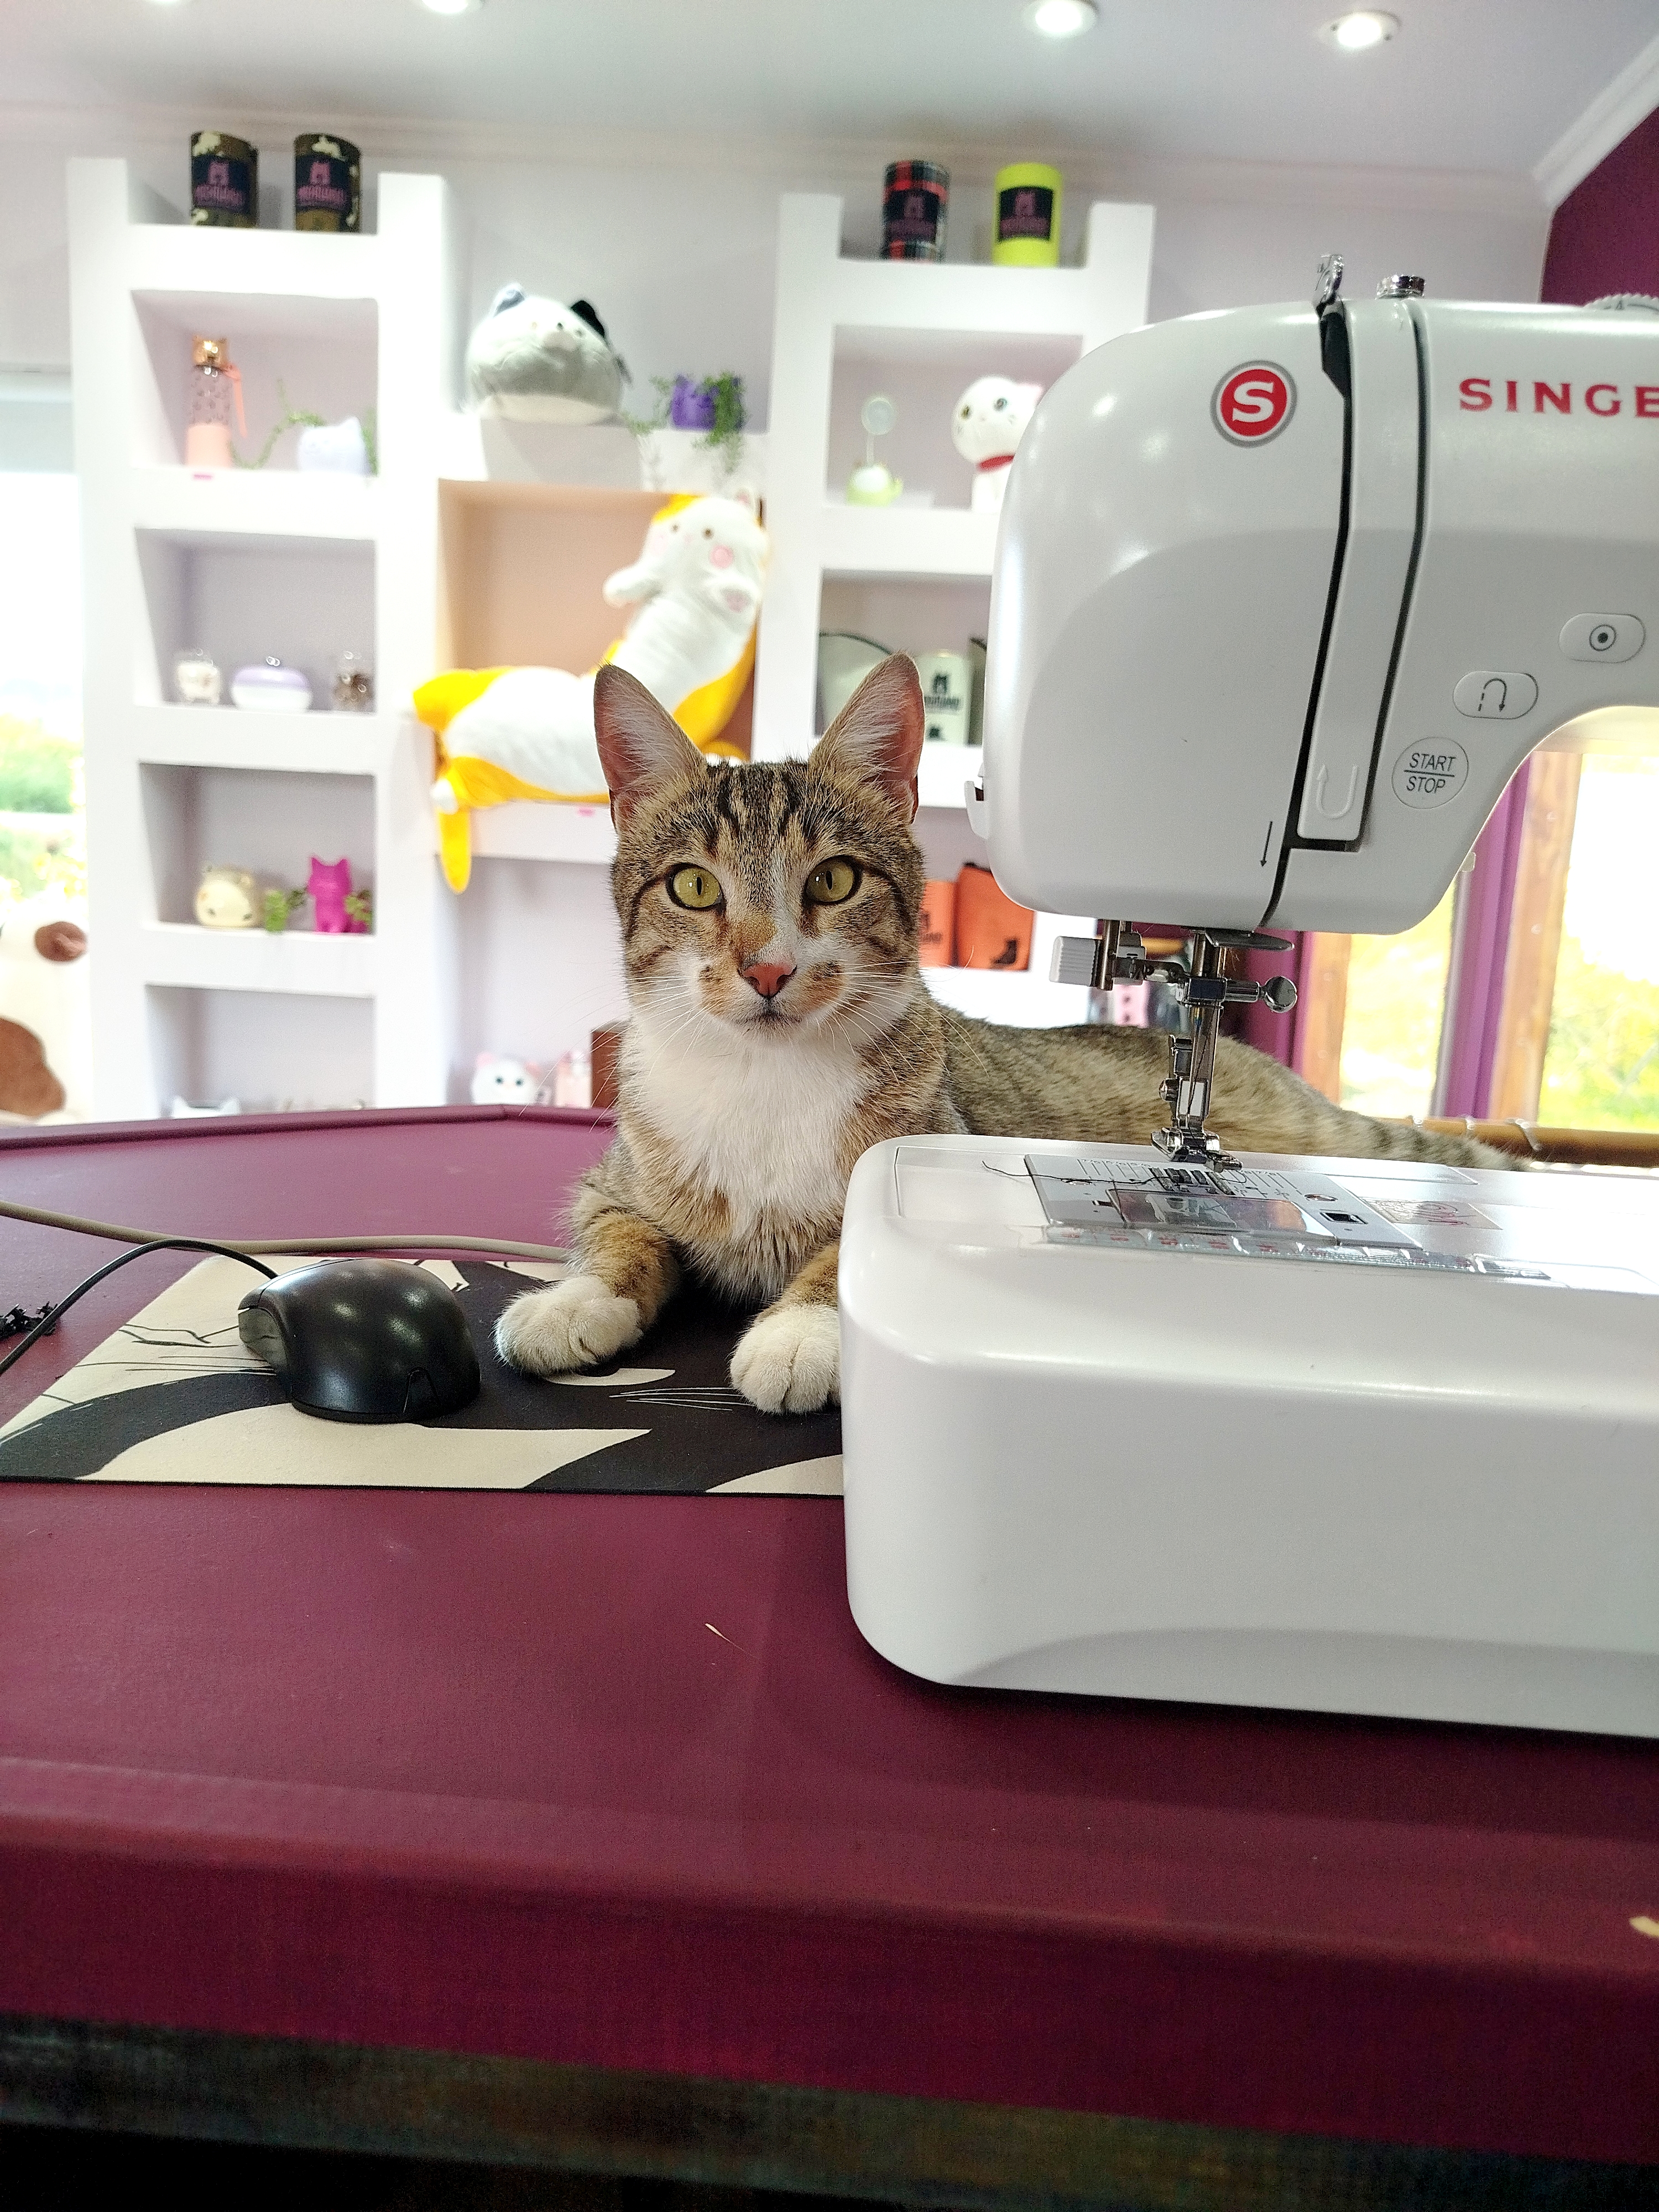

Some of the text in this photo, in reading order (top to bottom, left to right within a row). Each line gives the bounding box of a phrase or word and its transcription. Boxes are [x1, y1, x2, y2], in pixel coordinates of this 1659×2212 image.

[1232, 381, 1274, 423] S
[1459, 377, 1659, 418] SINGE
[1409, 753, 1457, 771] START
[1406, 775, 1446, 794] STOP
